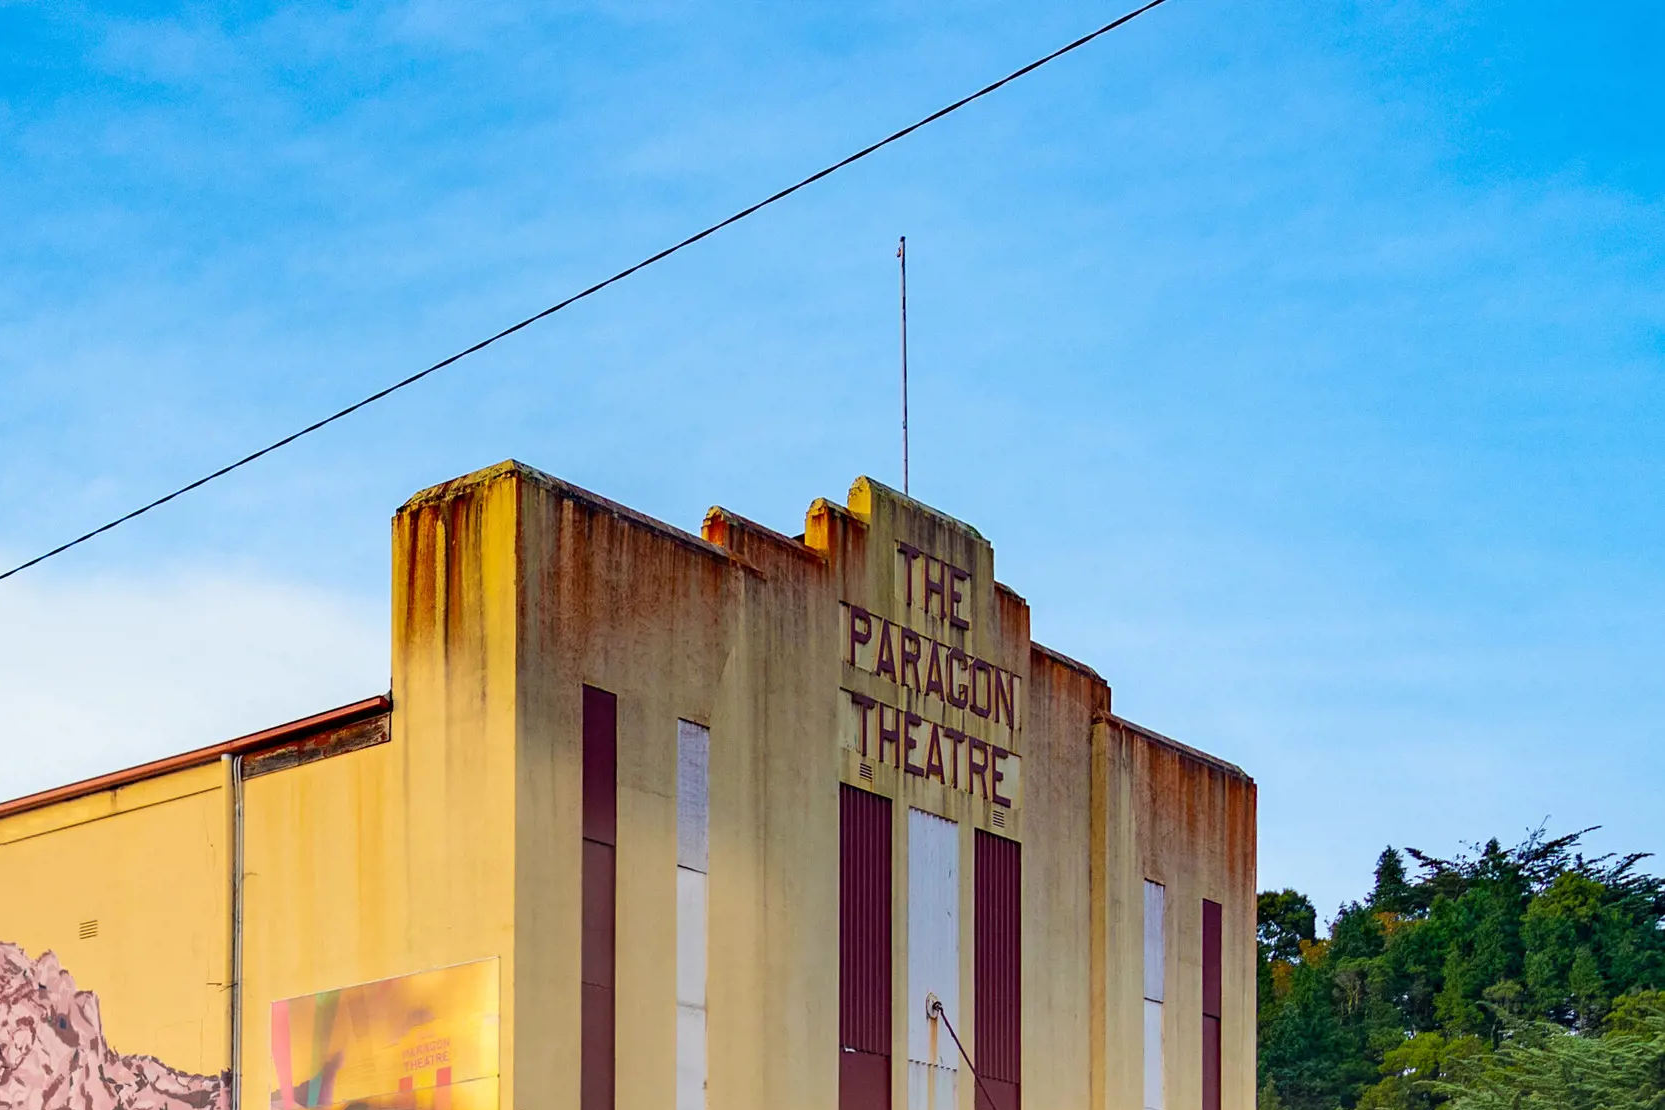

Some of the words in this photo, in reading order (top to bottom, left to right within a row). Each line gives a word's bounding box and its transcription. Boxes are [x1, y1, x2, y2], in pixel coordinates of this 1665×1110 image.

[896, 541, 970, 631] THE
[849, 605, 1015, 731] PARAGON
[851, 691, 1012, 809] THEATRE
[403, 1050, 449, 1072] THEATRE
